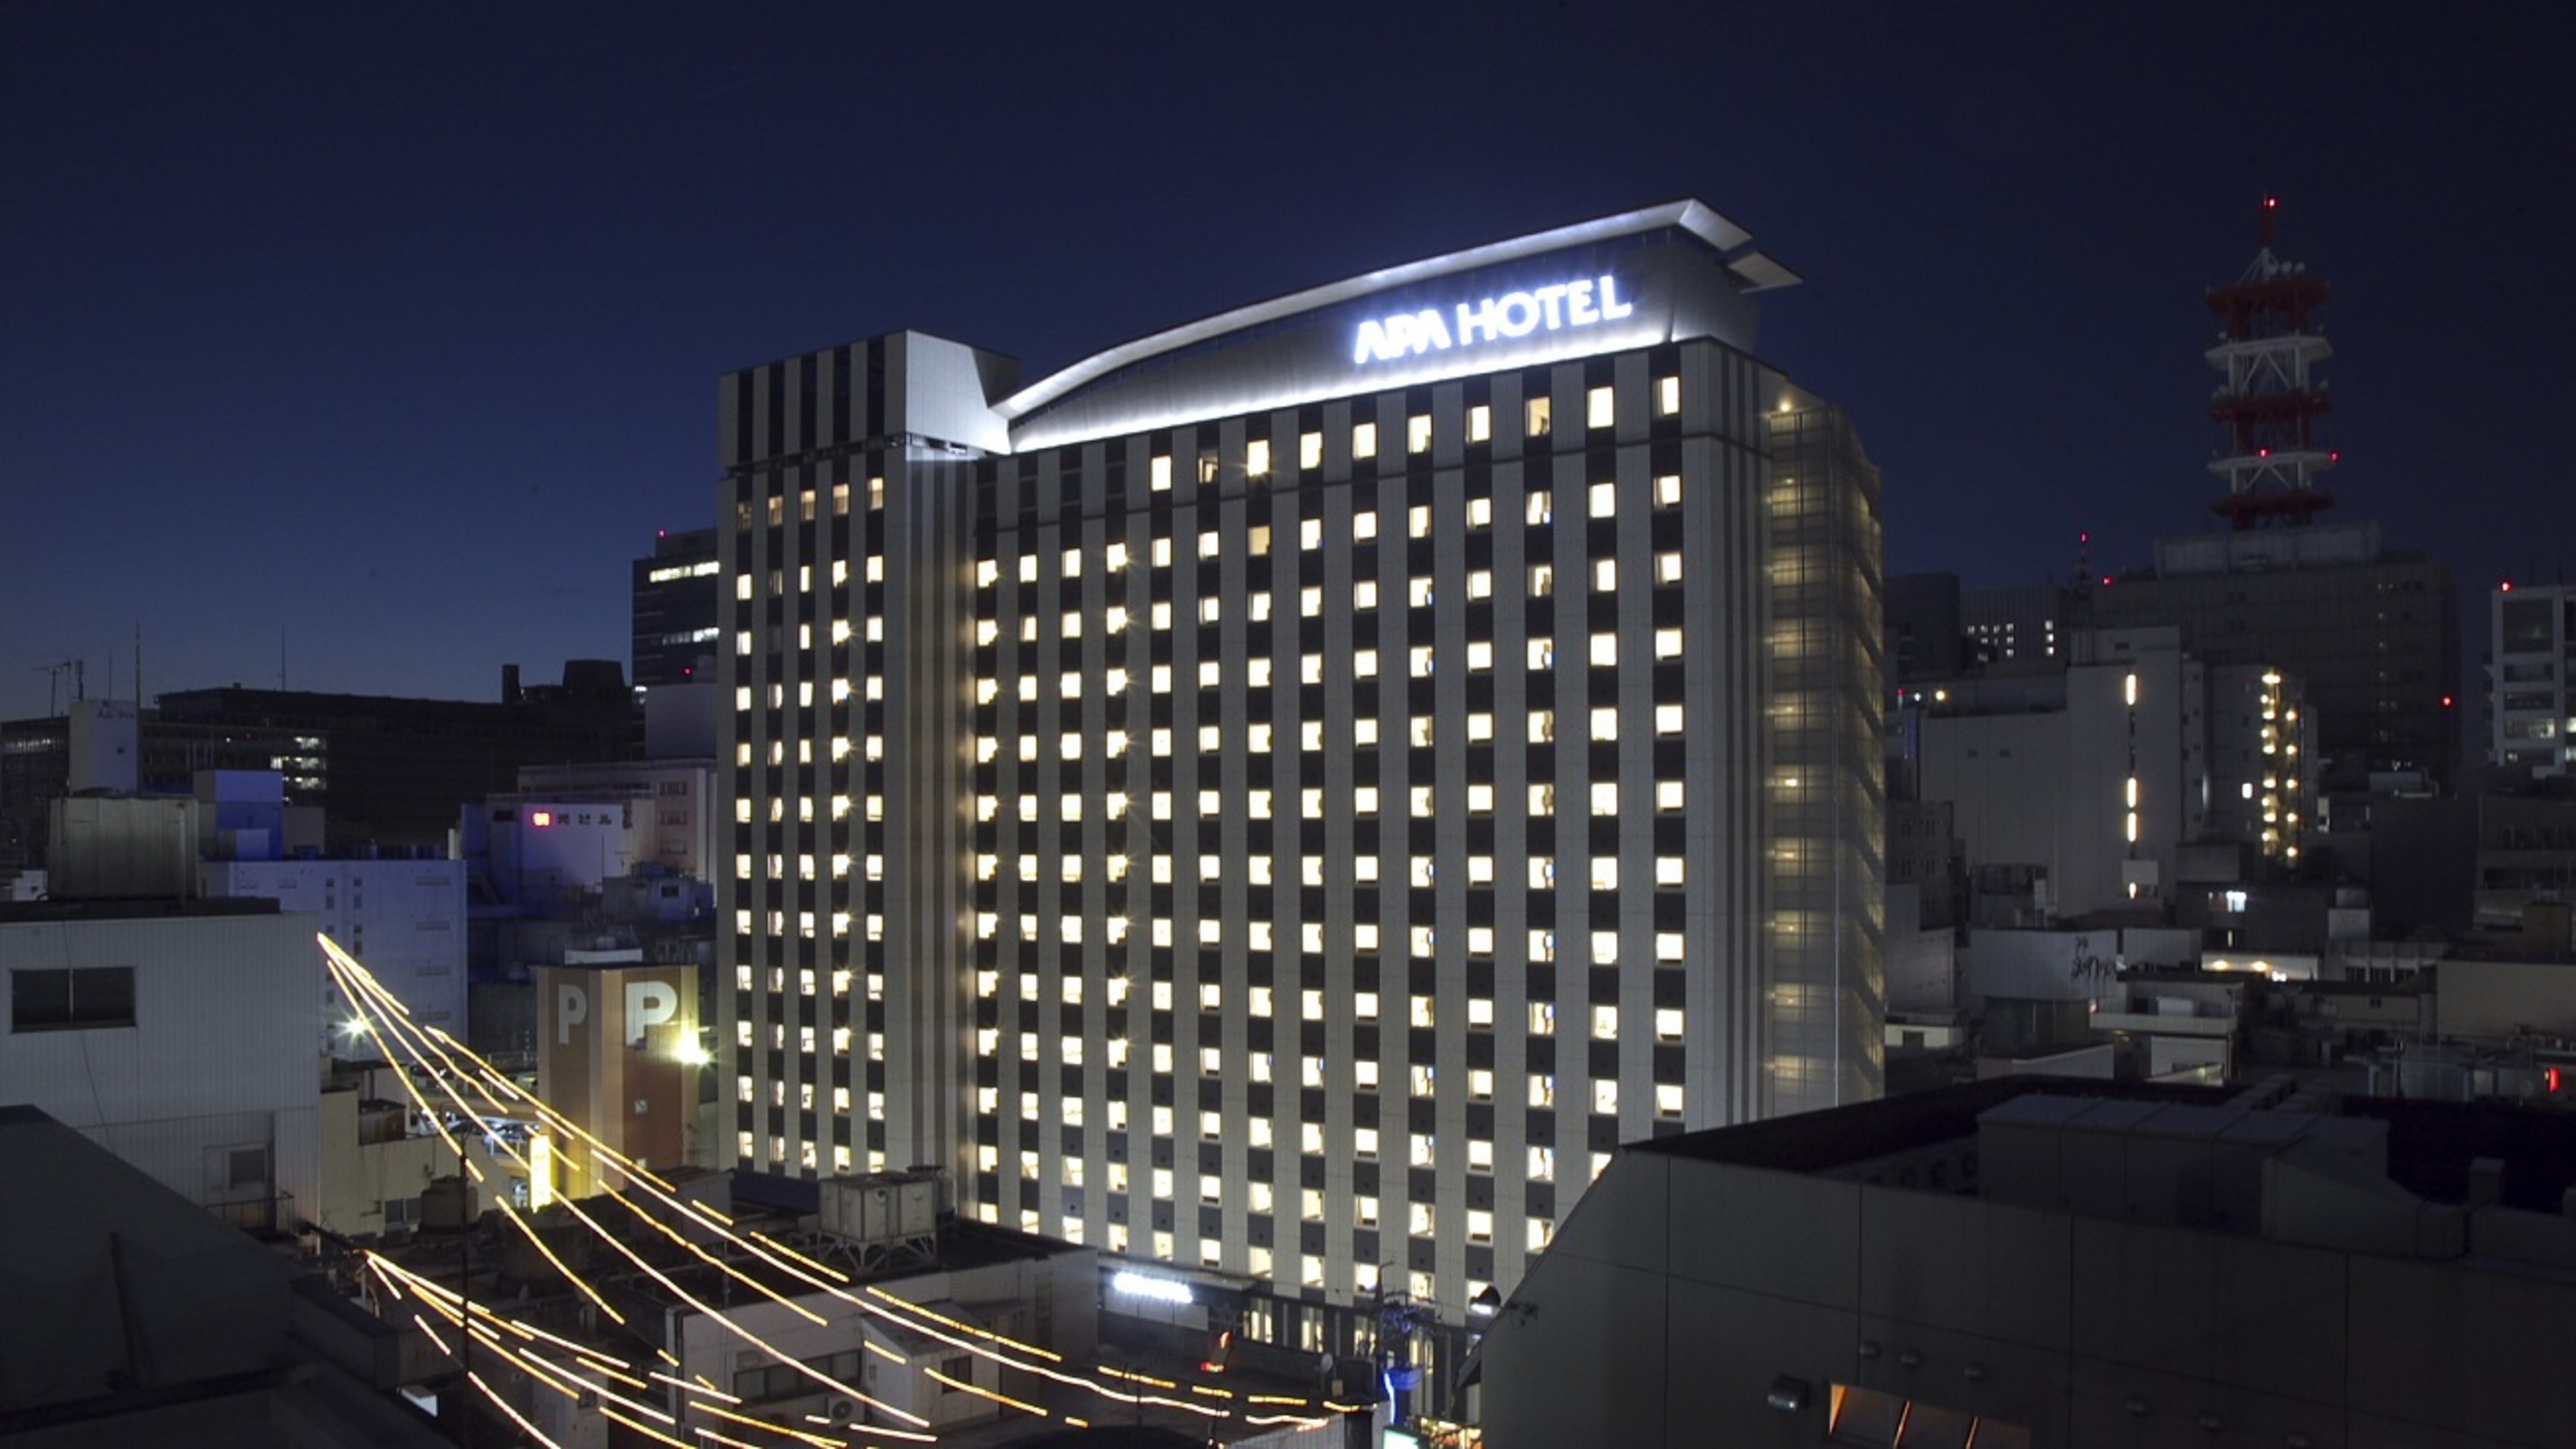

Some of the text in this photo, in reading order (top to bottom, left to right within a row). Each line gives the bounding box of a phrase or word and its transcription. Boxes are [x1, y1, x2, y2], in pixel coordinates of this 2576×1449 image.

[1355, 275, 1633, 364] APA HOTEL
[558, 984, 587, 1045] P
[625, 980, 677, 1046] P
